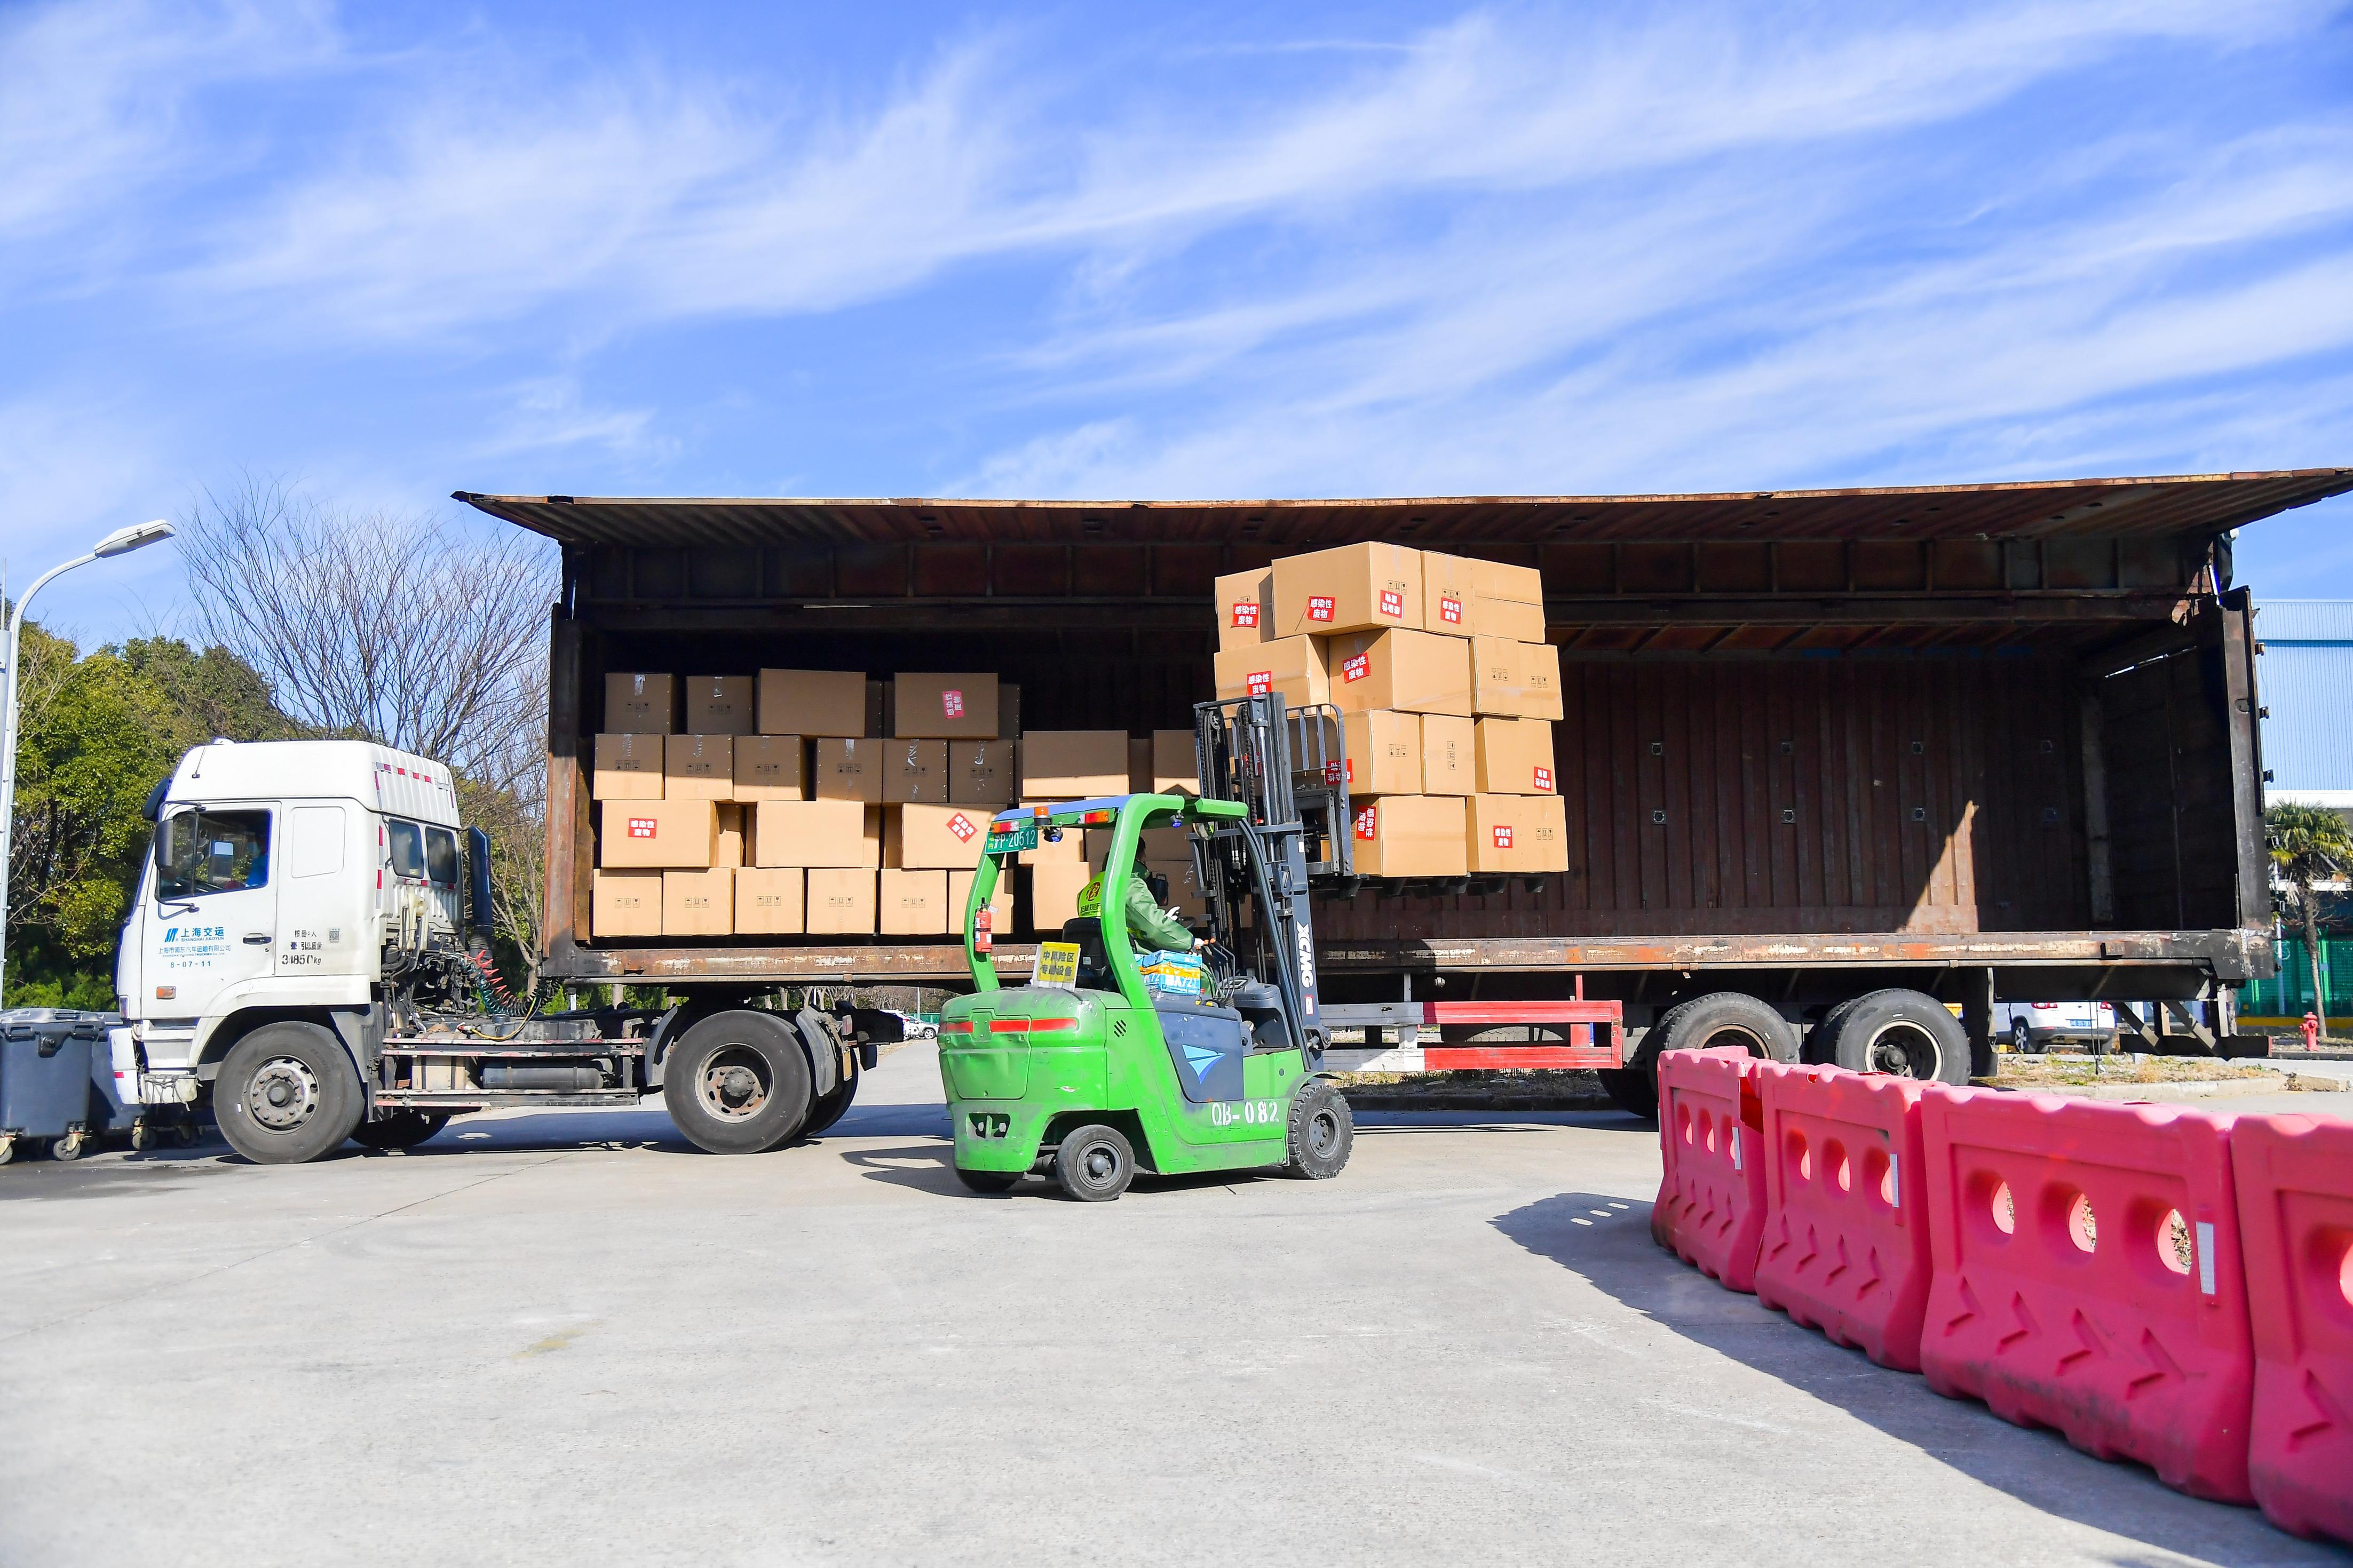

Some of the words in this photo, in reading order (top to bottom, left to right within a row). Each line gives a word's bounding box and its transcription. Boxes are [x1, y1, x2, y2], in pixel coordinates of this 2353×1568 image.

[1310, 598, 1333, 608] 感染性
[1235, 605, 1257, 615] 感染性
[1313, 609, 1328, 619] 废物
[1238, 615, 1253, 625] 废物
[1344, 656, 1367, 671] 感染性
[1248, 673, 1270, 684] 感染性
[1349, 667, 1364, 680] 废物
[1252, 684, 1266, 694] 废物
[181, 927, 224, 937] 上海交运
[159, 944, 231, 954] 上海市浦东汽车运输有限公司
[1043, 951, 1074, 962] 中风险区
[1296, 921, 1314, 988] XCMG
[170, 960, 211, 968] 8-07-11
